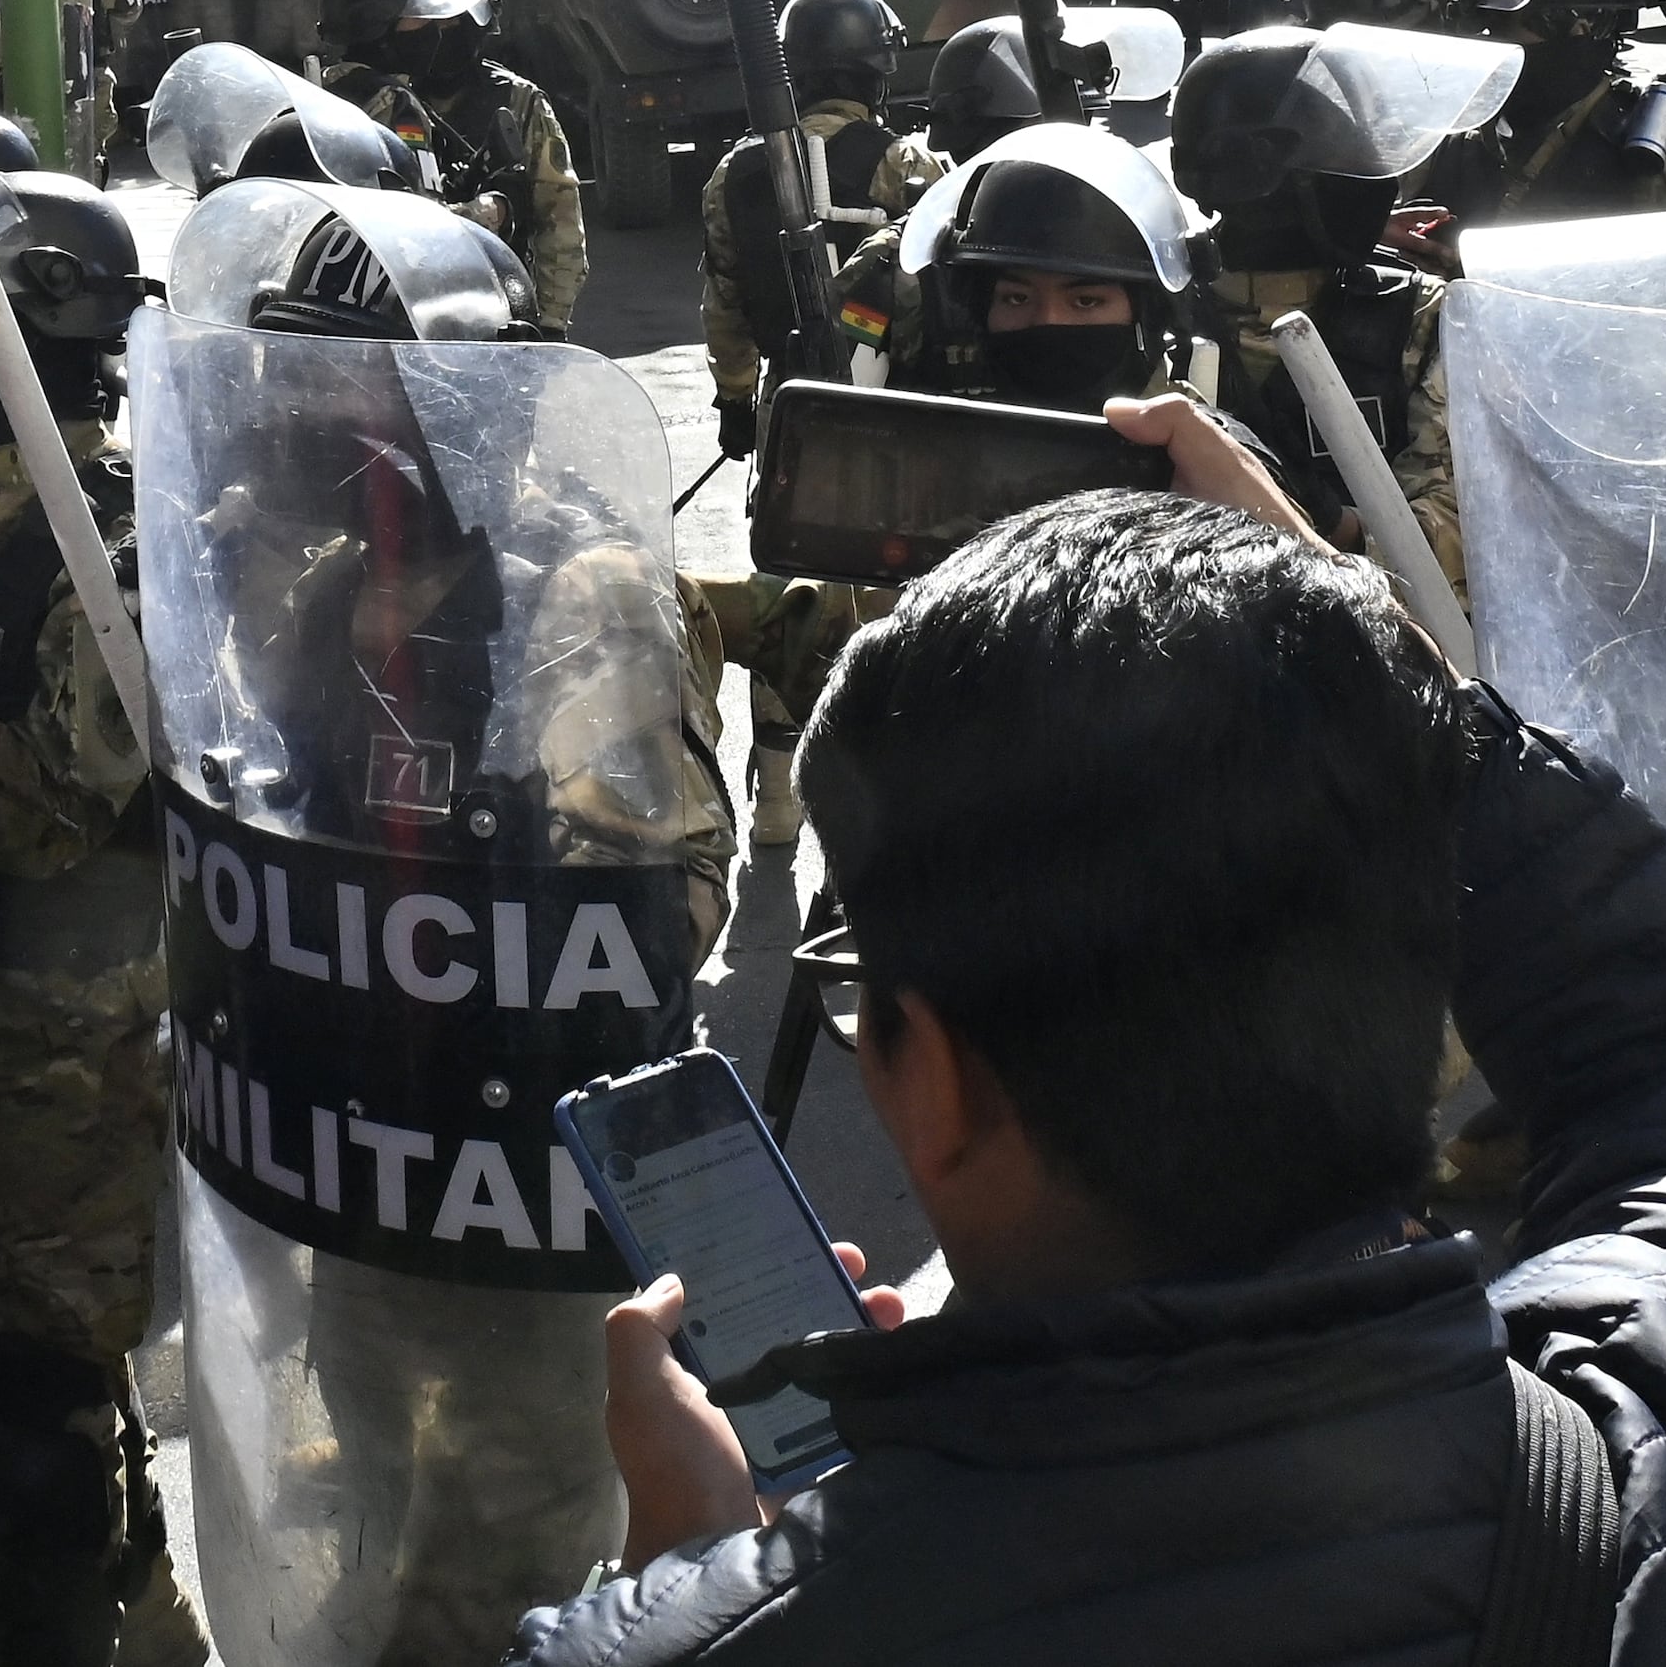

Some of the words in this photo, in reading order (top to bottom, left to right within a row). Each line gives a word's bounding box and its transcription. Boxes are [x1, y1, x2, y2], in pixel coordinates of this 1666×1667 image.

[302, 225, 393, 312] PM
[393, 752, 429, 797] 71
[164, 805, 660, 1010] POLICIA
